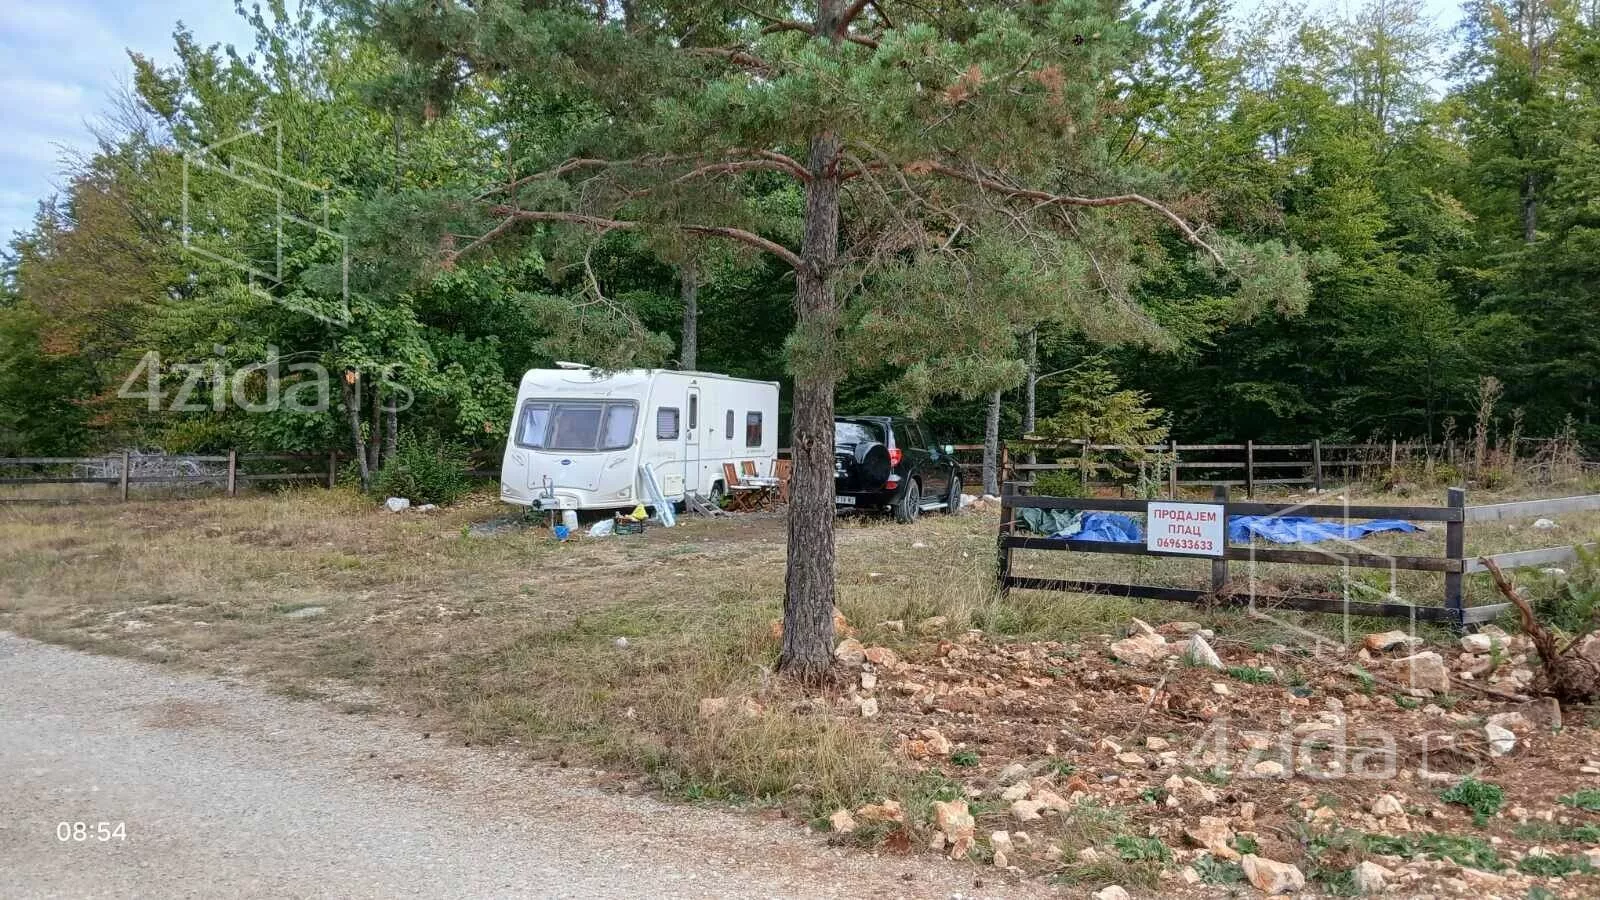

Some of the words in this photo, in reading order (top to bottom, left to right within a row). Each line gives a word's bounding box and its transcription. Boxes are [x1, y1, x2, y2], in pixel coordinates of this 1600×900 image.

[1153, 509, 1216, 521] ПРОДАЈЕМ
[1168, 524, 1202, 536] ПЛАЦ
[1157, 538, 1213, 550] 069633633
